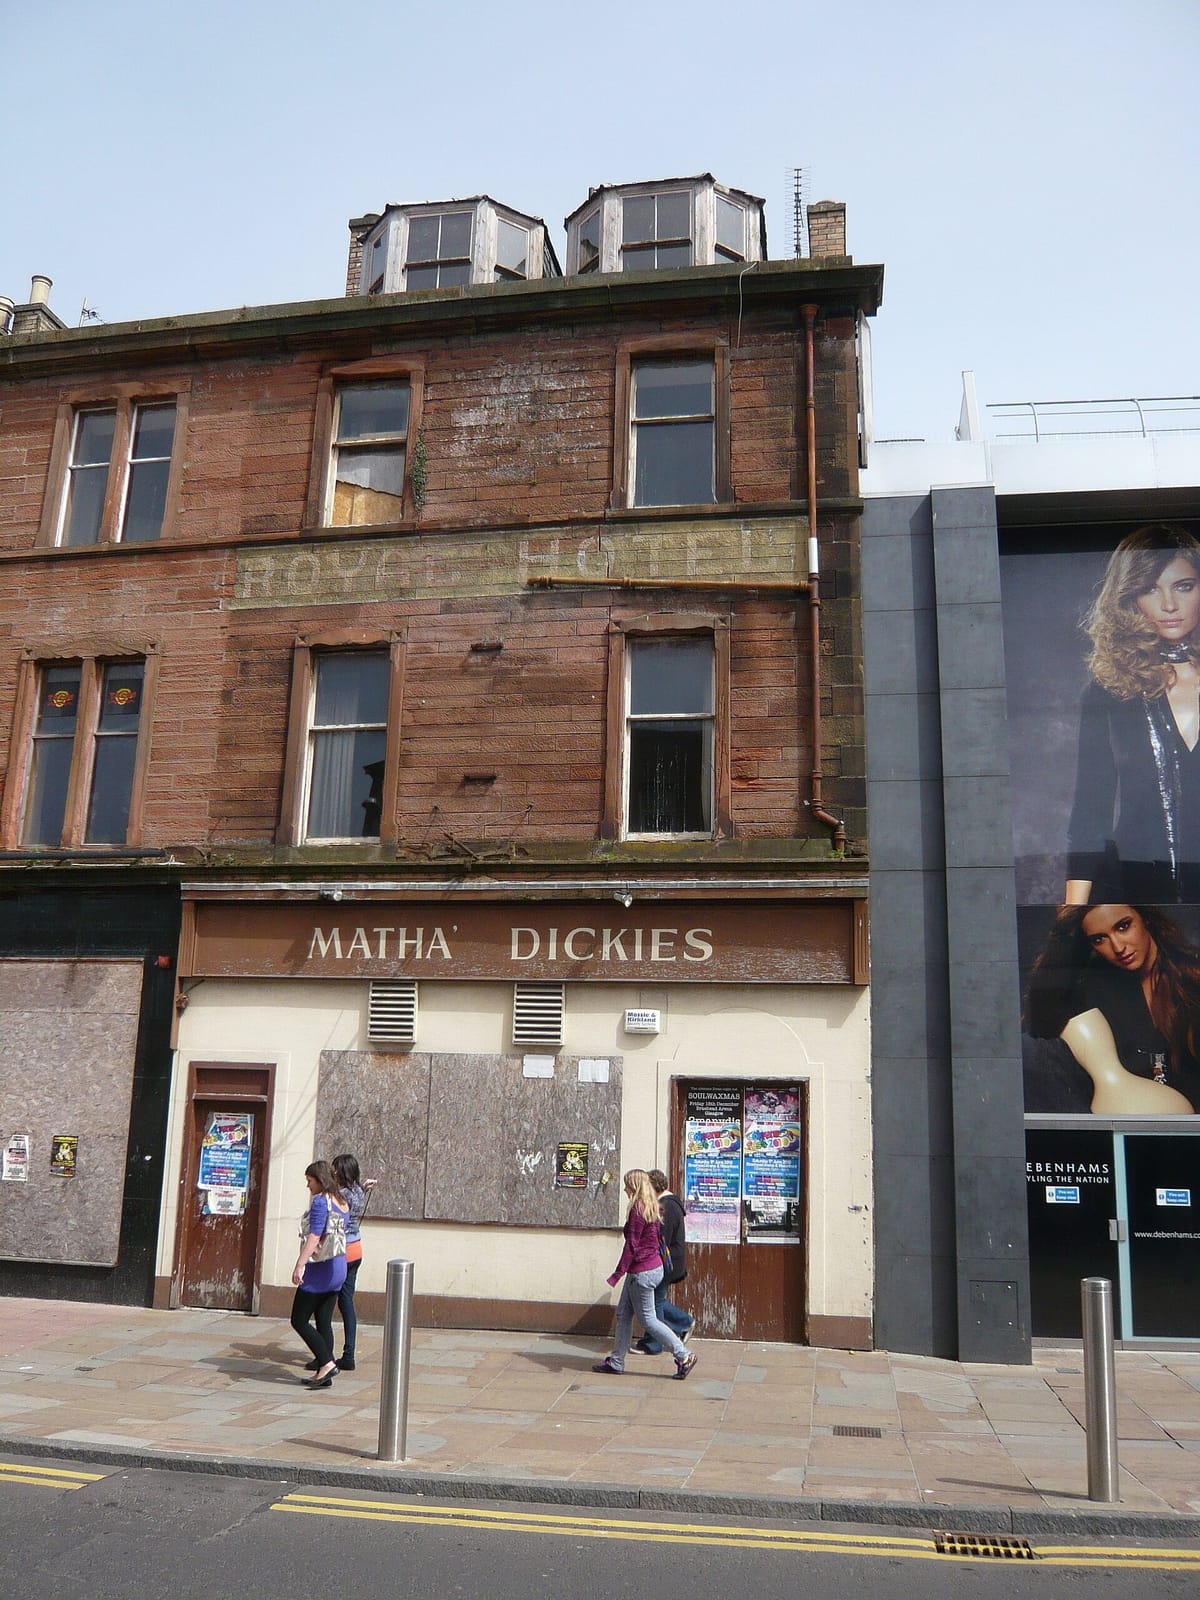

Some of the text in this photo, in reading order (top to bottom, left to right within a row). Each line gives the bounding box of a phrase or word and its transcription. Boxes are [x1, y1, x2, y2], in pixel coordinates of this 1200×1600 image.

[307, 925, 713, 962] MATHA' DICKIES
[688, 1092, 741, 1100] SOULWAXMAS
[1026, 1162, 1109, 1174] EBENHAMS
[1026, 1175, 1109, 1184] YLING THE NATION
[1134, 1230, 1200, 1239] www.debenhams.co
